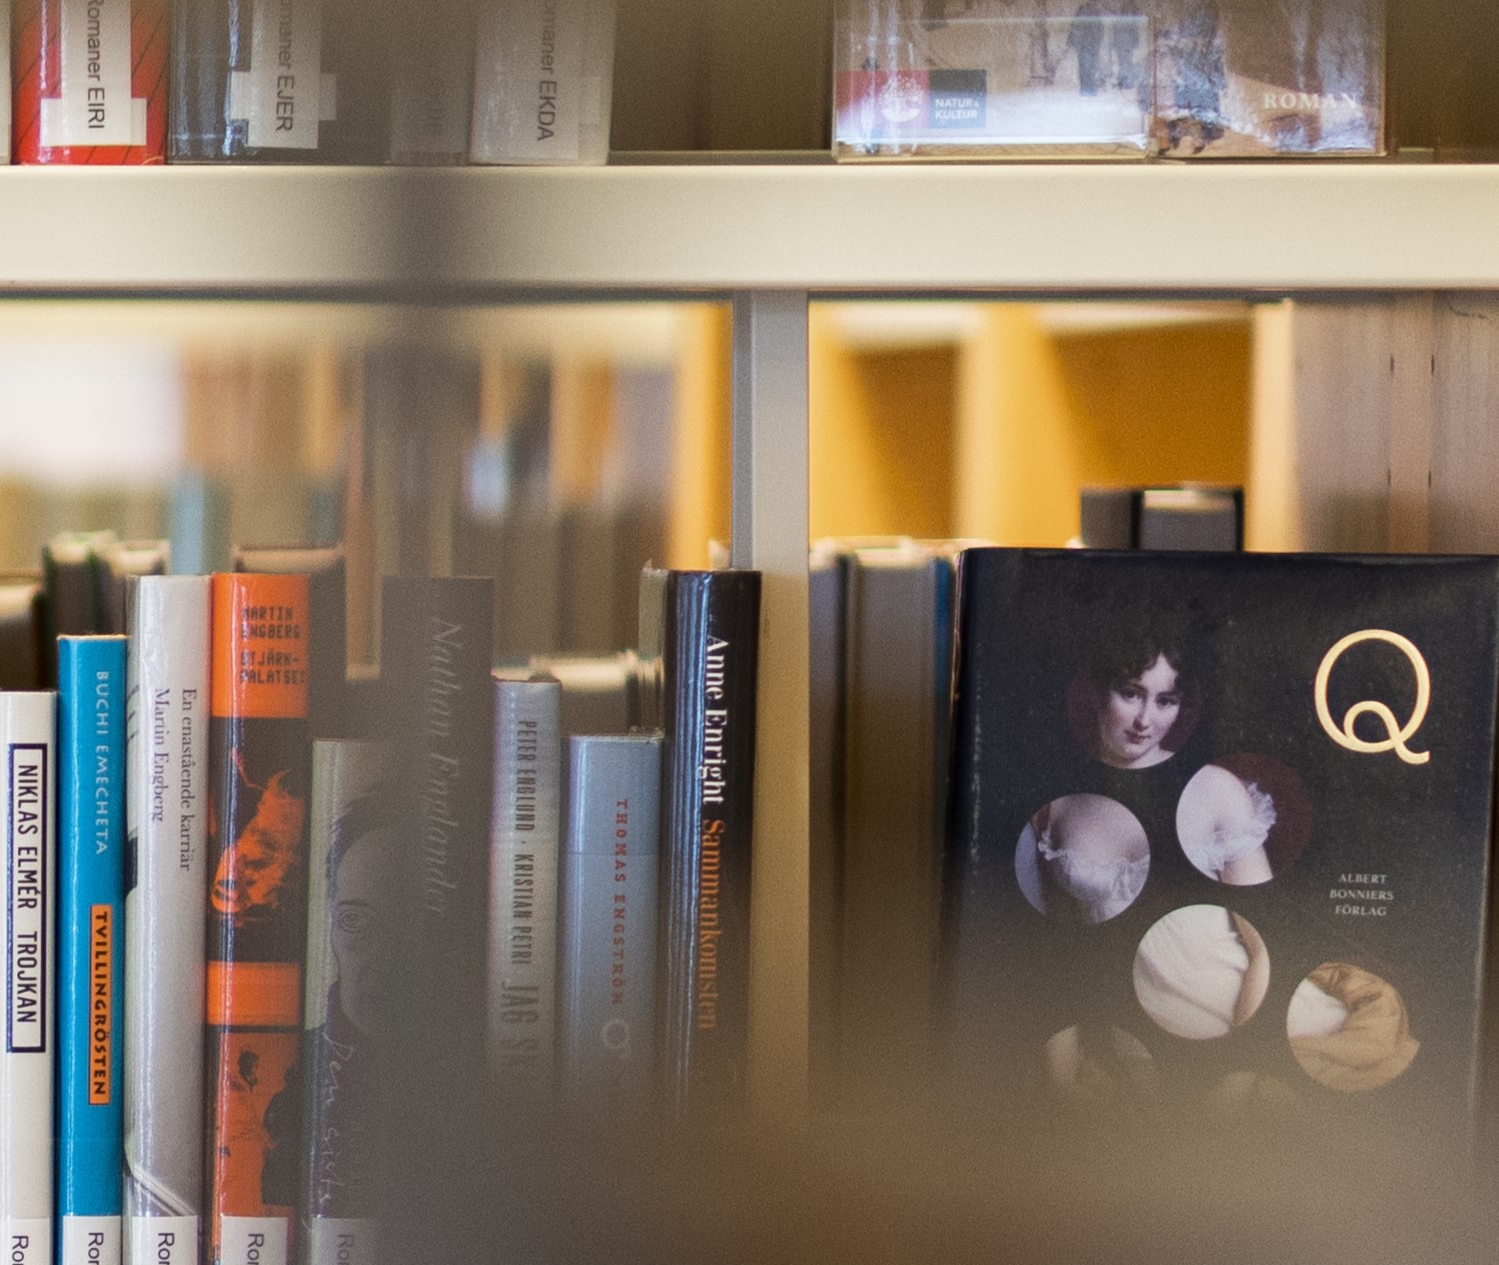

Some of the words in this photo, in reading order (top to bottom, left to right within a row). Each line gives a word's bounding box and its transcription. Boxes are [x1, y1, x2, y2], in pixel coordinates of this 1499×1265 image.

[88, 88, 106, 129] EIRI
[536, 77, 555, 142] EKDA
[1263, 93, 1357, 110] ROMAN
[705, 634, 729, 699] Anne
[1313, 629, 1430, 765] Q
[95, 671, 109, 736] BUCHI
[153, 688, 170, 744] Martin
[180, 688, 196, 711] En
[151, 752, 169, 822] Engberg
[180, 717, 197, 808] enastående
[697, 708, 729, 804] Enright
[17, 765, 37, 835] NIKLAS
[95, 744, 109, 854] EMECHETA
[179, 814, 196, 871] karriär
[18, 846, 41, 909] ELMÉR
[1329, 888, 1394, 901] BONNIERS
[1334, 903, 1387, 917] FÖRLAG
[1338, 873, 1387, 885] ALBERT
[697, 818, 725, 1029] Sammankomsten
[17, 931, 37, 1023] TROJKAN
[93, 912, 111, 1095] TVILLINGRÖSTEN
